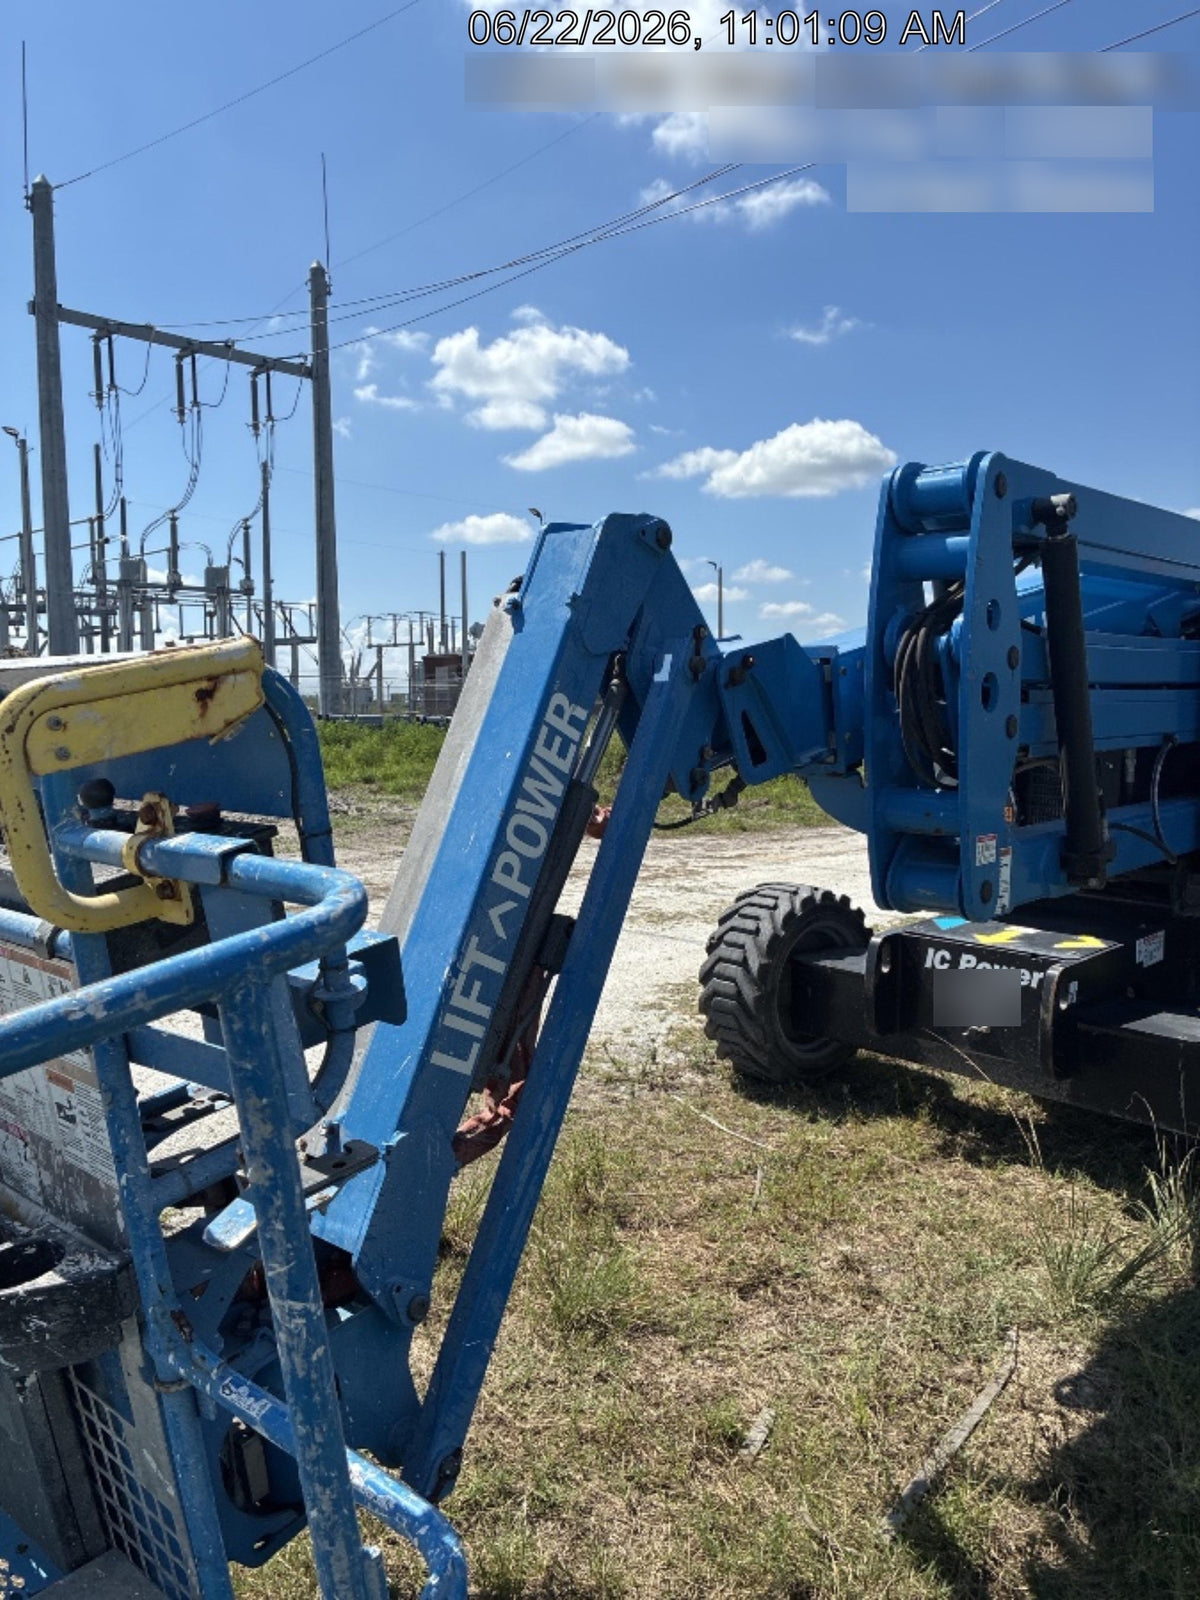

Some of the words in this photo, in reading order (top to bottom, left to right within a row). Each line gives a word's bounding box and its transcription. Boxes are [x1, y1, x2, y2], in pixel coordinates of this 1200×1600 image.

[430, 935, 507, 1077] LIFT
[491, 692, 589, 899] POWER
[924, 947, 952, 970] IC
[958, 952, 1044, 989] Per
